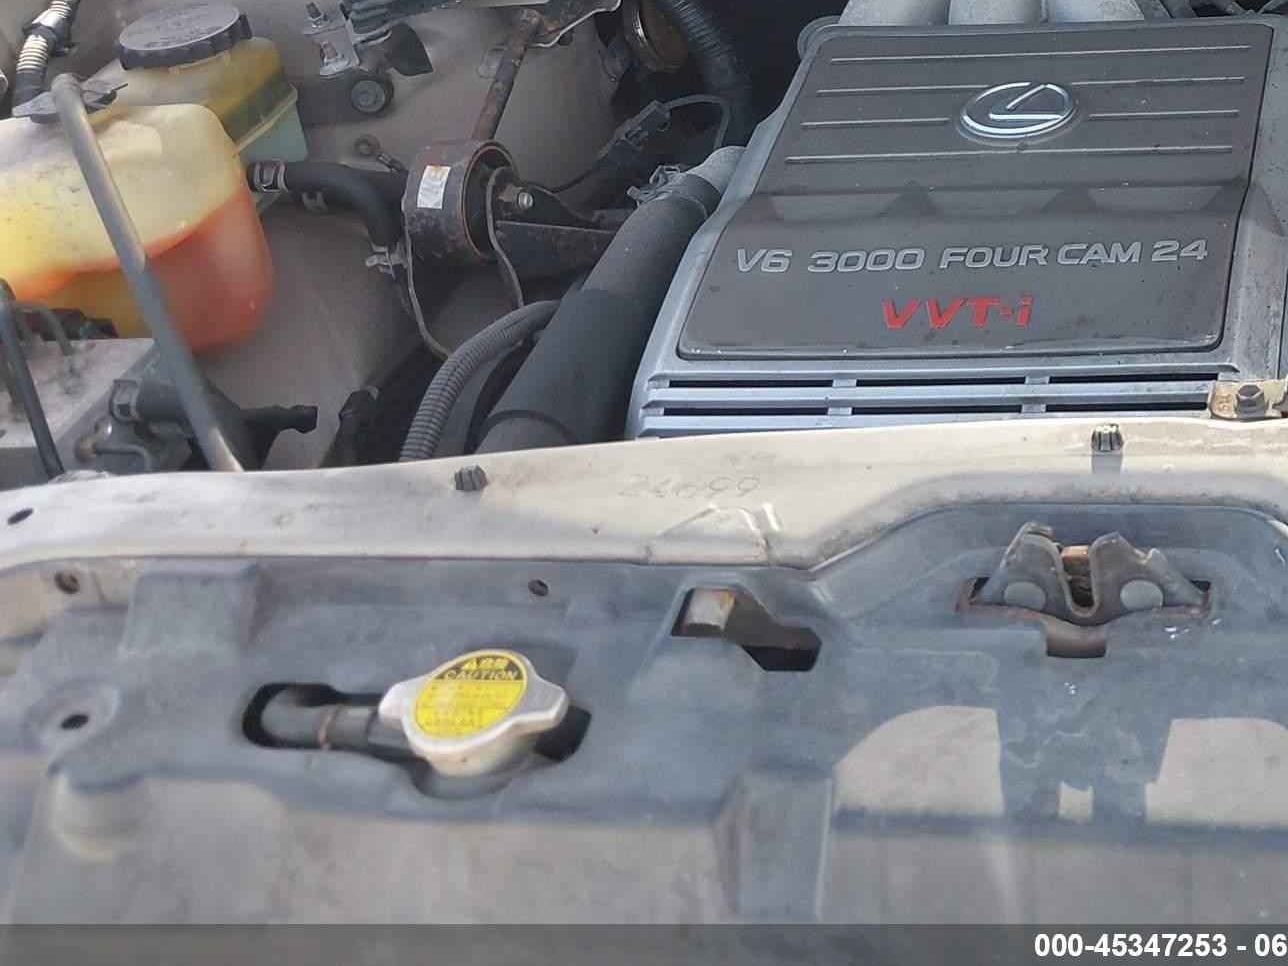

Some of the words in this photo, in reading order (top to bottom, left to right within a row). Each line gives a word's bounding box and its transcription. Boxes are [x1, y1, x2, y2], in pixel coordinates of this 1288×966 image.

[737, 248, 793, 273] V6
[807, 247, 926, 273] 3000
[939, 243, 1050, 269] FOUR
[1056, 240, 1143, 265] CAM
[1151, 238, 1208, 263] 24
[880, 295, 1034, 330] VVT-i
[443, 669, 519, 682] CAUTION
